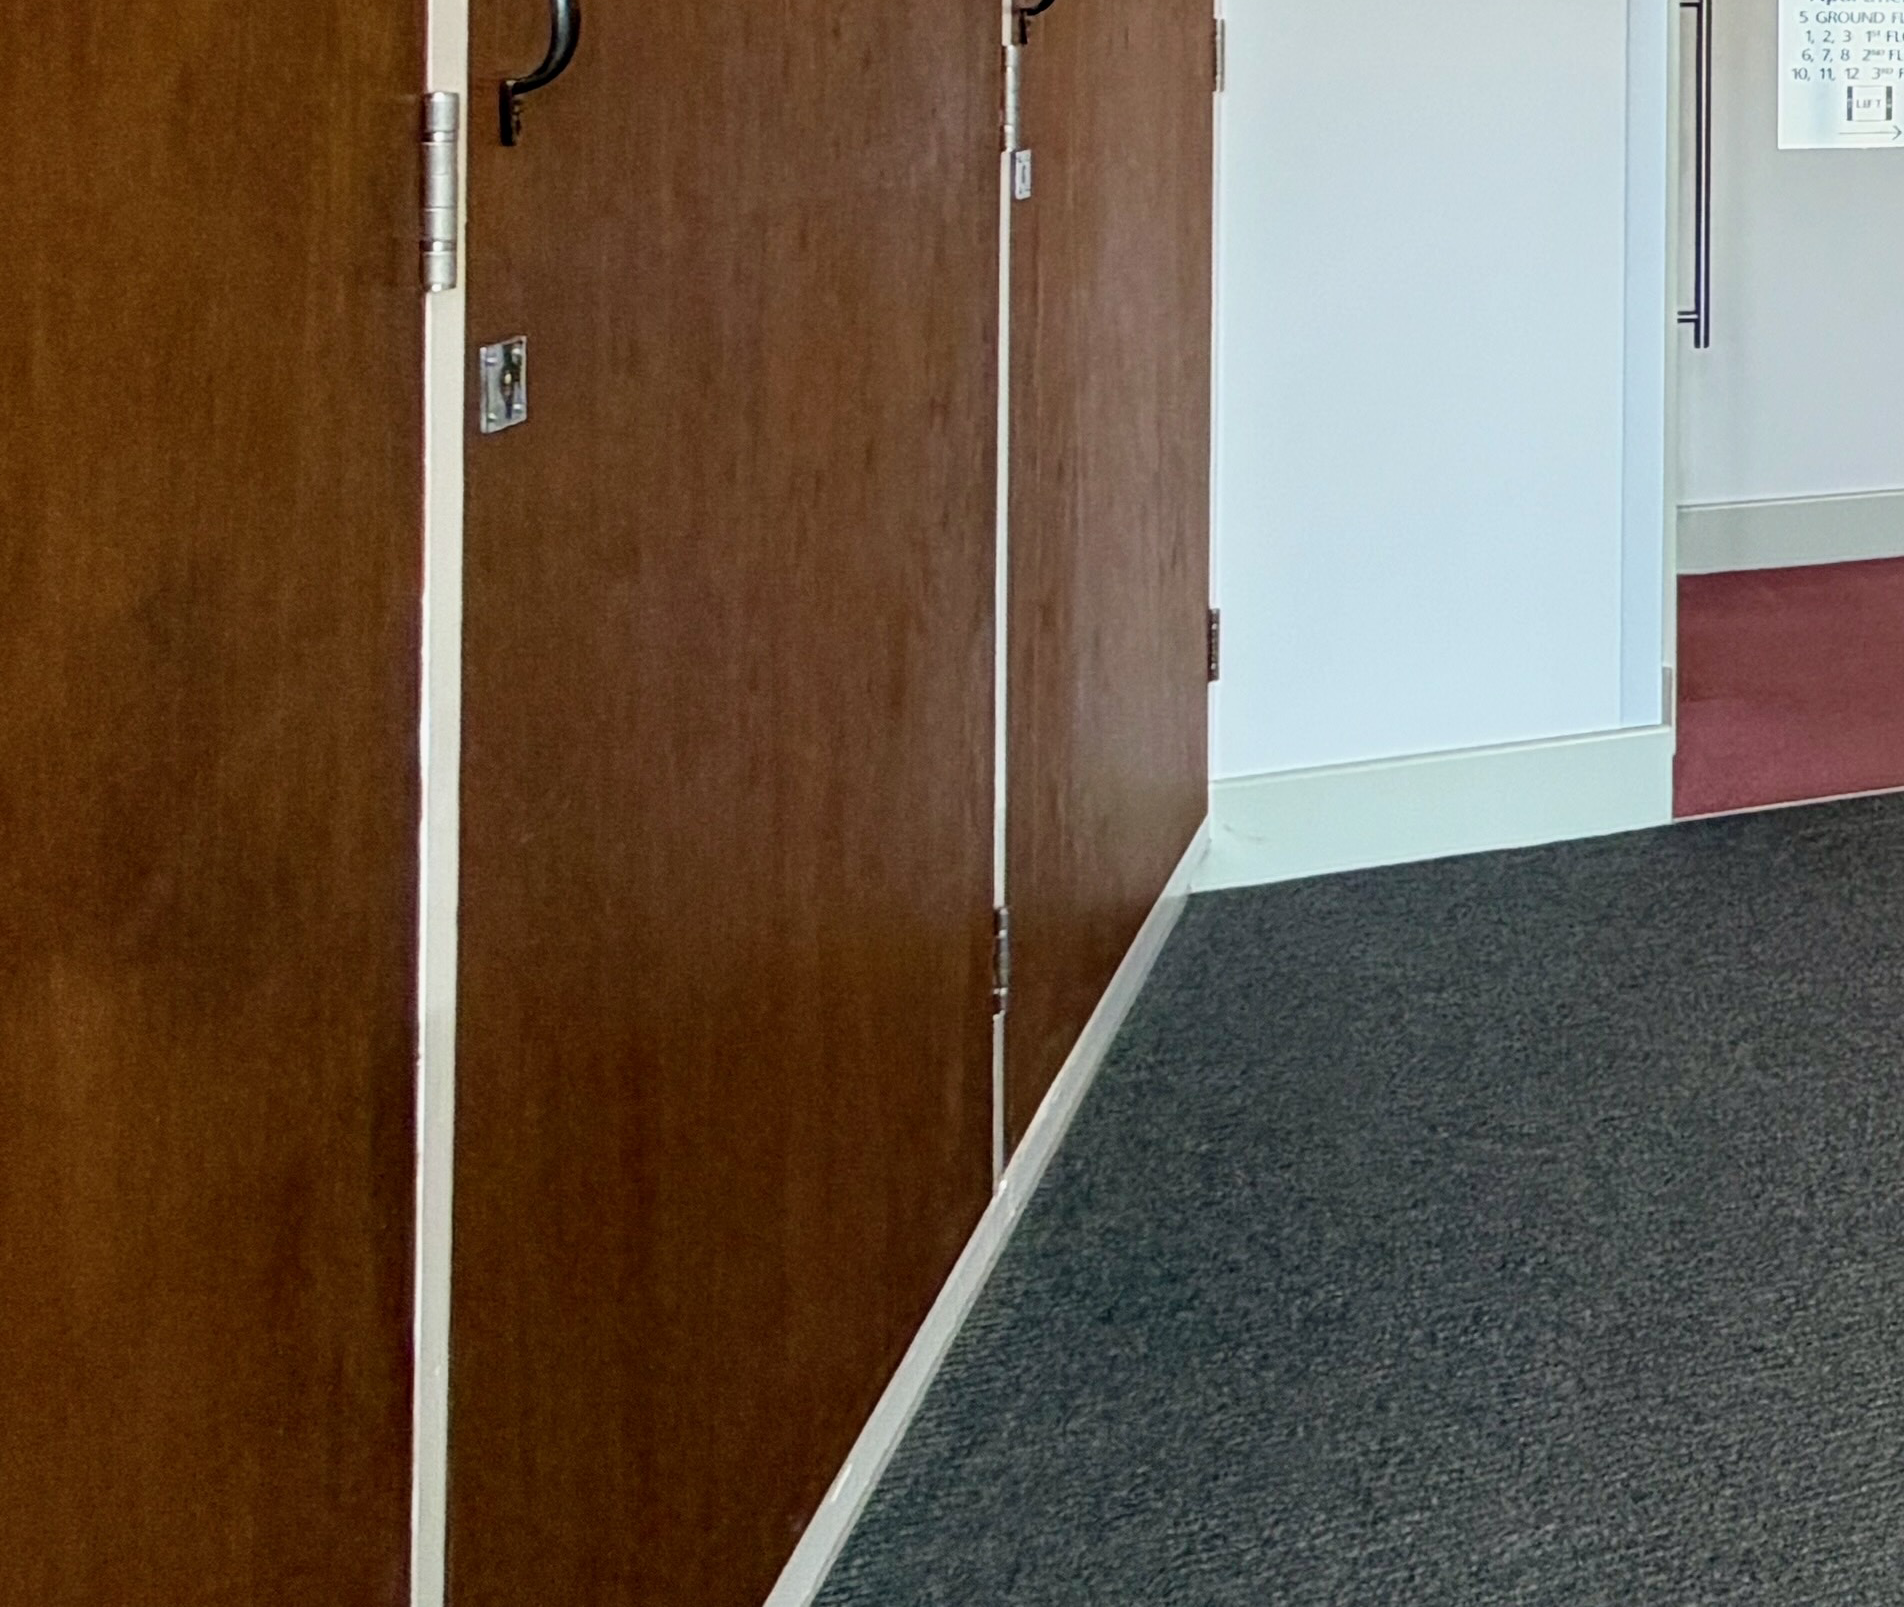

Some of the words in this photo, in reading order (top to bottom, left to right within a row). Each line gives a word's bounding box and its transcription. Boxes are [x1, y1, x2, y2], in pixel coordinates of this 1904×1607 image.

[1799, 10, 1809, 25] 5
[1815, 10, 1886, 25] GROUND
[1805, 29, 1815, 45] 1,
[1822, 29, 1835, 45] 2,
[1842, 29, 1852, 44] 3
[1801, 48, 1815, 63] 6,
[1822, 48, 1834, 63] 7,
[1840, 48, 1850, 62] 8
[1792, 67, 1812, 82] 10,
[1820, 67, 1837, 82] 11,
[1845, 67, 1861, 80] 12
[1856, 97, 1882, 109] LIFT
